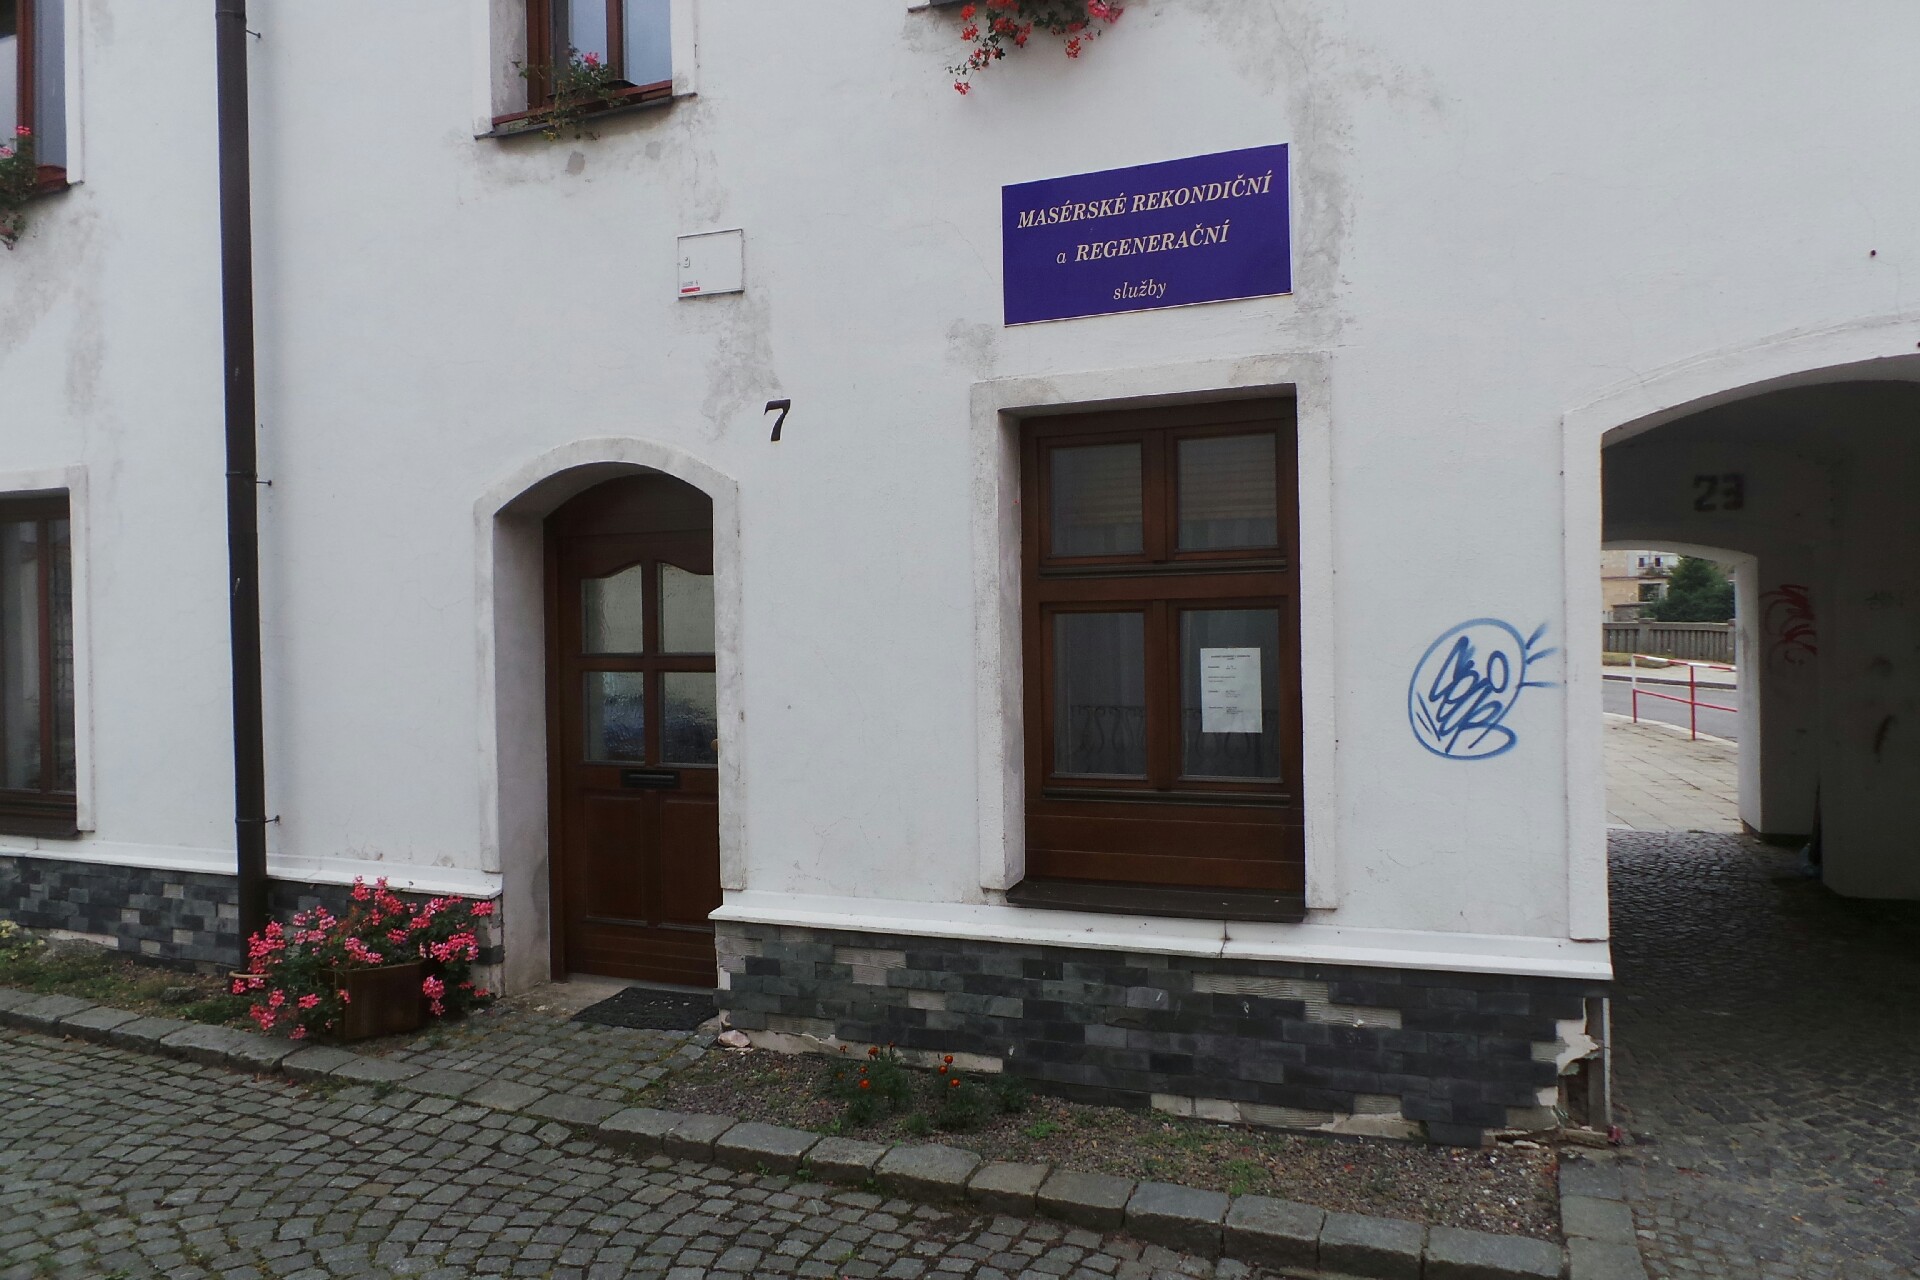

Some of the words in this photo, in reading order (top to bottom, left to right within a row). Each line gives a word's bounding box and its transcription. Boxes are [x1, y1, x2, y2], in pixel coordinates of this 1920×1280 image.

[1017, 192, 1127, 229] MASÉRSKÉ
[1131, 170, 1273, 212] REKONDIČNÍ
[1056, 252, 1067, 264] a
[1074, 219, 1231, 262] REGENERAČNÍ
[1113, 278, 1167, 300] služby
[763, 399, 791, 442] 7
[1692, 472, 1745, 512] 23
